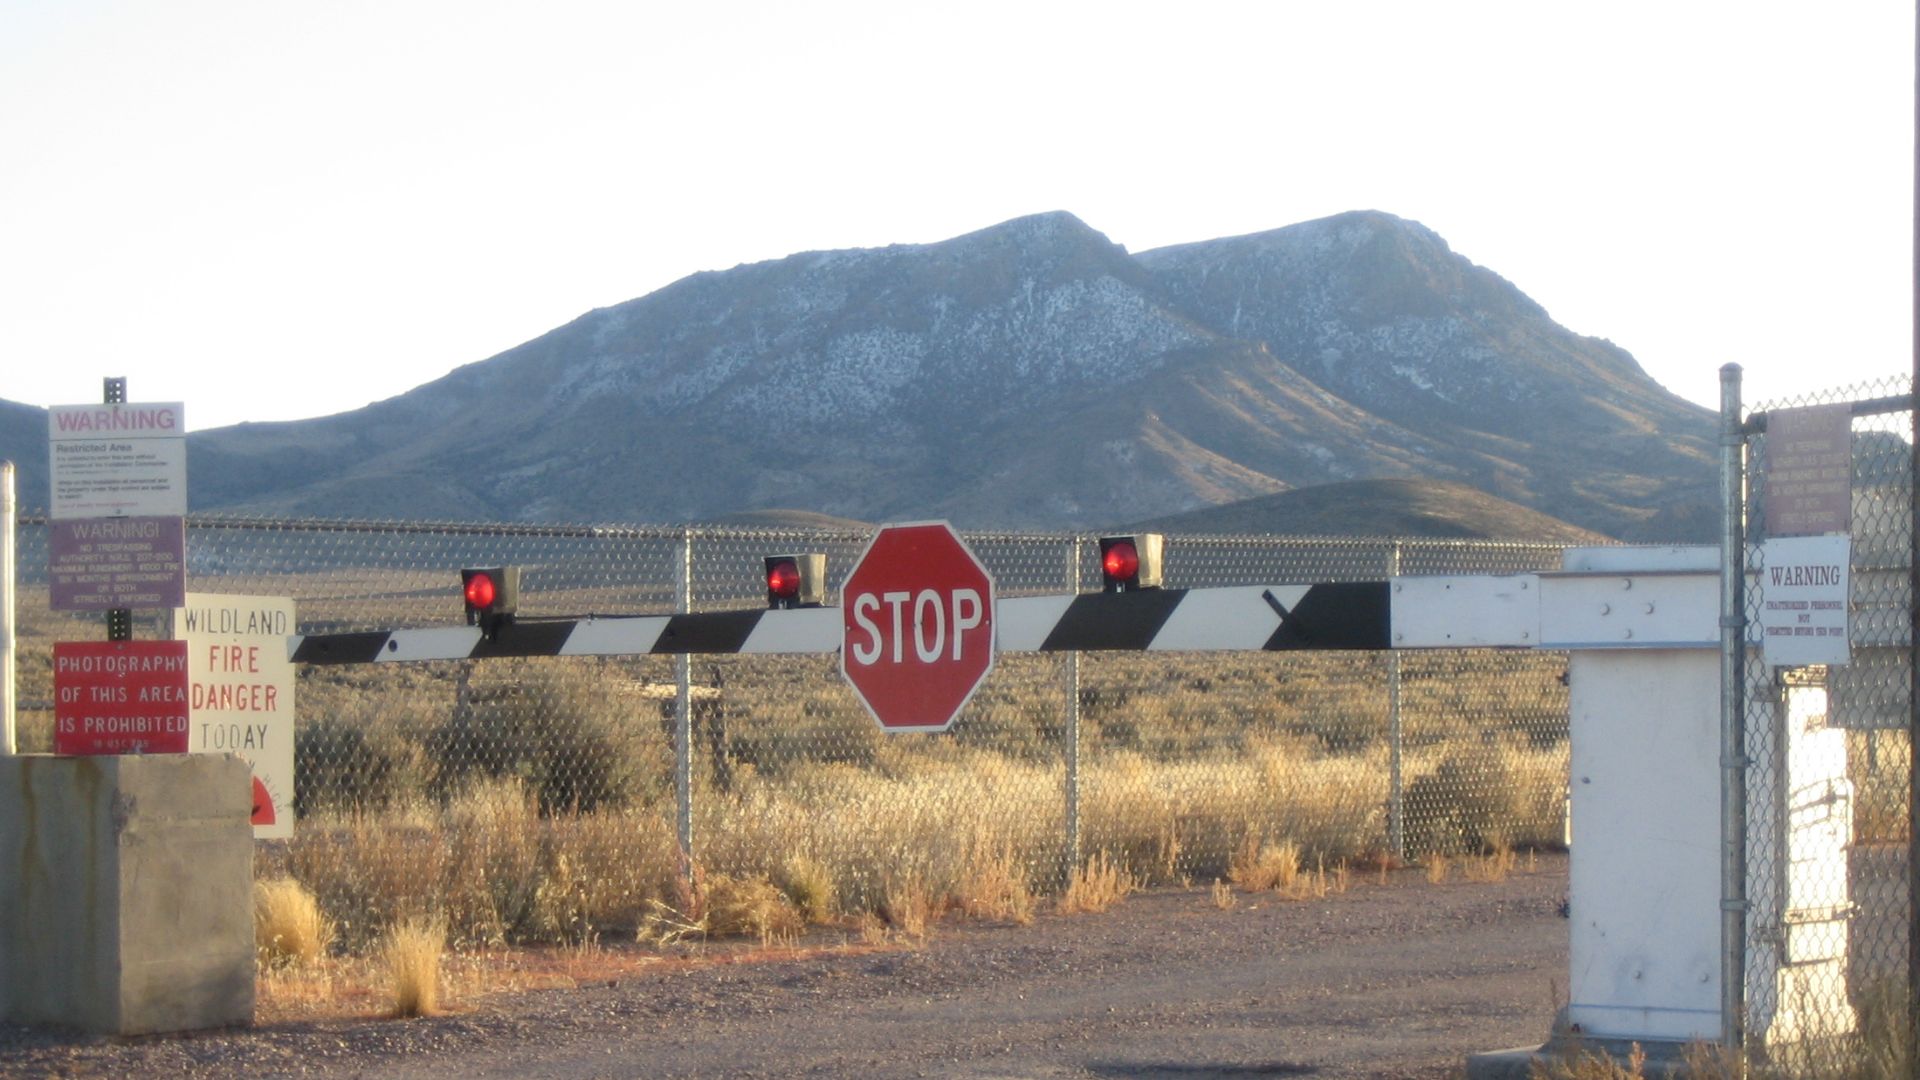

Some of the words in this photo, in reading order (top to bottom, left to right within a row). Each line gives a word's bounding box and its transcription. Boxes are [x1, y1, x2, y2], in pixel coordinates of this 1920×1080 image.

[56, 409, 176, 432] WARNING
[56, 444, 107, 453] Restricted
[110, 443, 133, 452] Area
[72, 521, 160, 539] WARNING!
[80, 544, 93, 553] NO
[96, 543, 152, 552] TRESPASSING
[59, 554, 104, 562] AUTHORITY
[1770, 566, 1841, 587] WARNING
[97, 584, 110, 593] OR
[113, 584, 137, 592] BOTH
[72, 594, 114, 603] STRICTLY
[118, 594, 161, 603] ENFORCED
[185, 608, 287, 635] WILDLAND
[853, 588, 983, 666] STOP
[58, 655, 186, 672] PHOTOGRAPHY
[209, 645, 260, 673] FIRE
[61, 687, 82, 703] OF
[90, 687, 128, 703] THIS
[138, 686, 186, 702] AREA
[192, 683, 277, 712] DANGER
[59, 717, 76, 733] IS
[201, 723, 269, 750] TODAY
